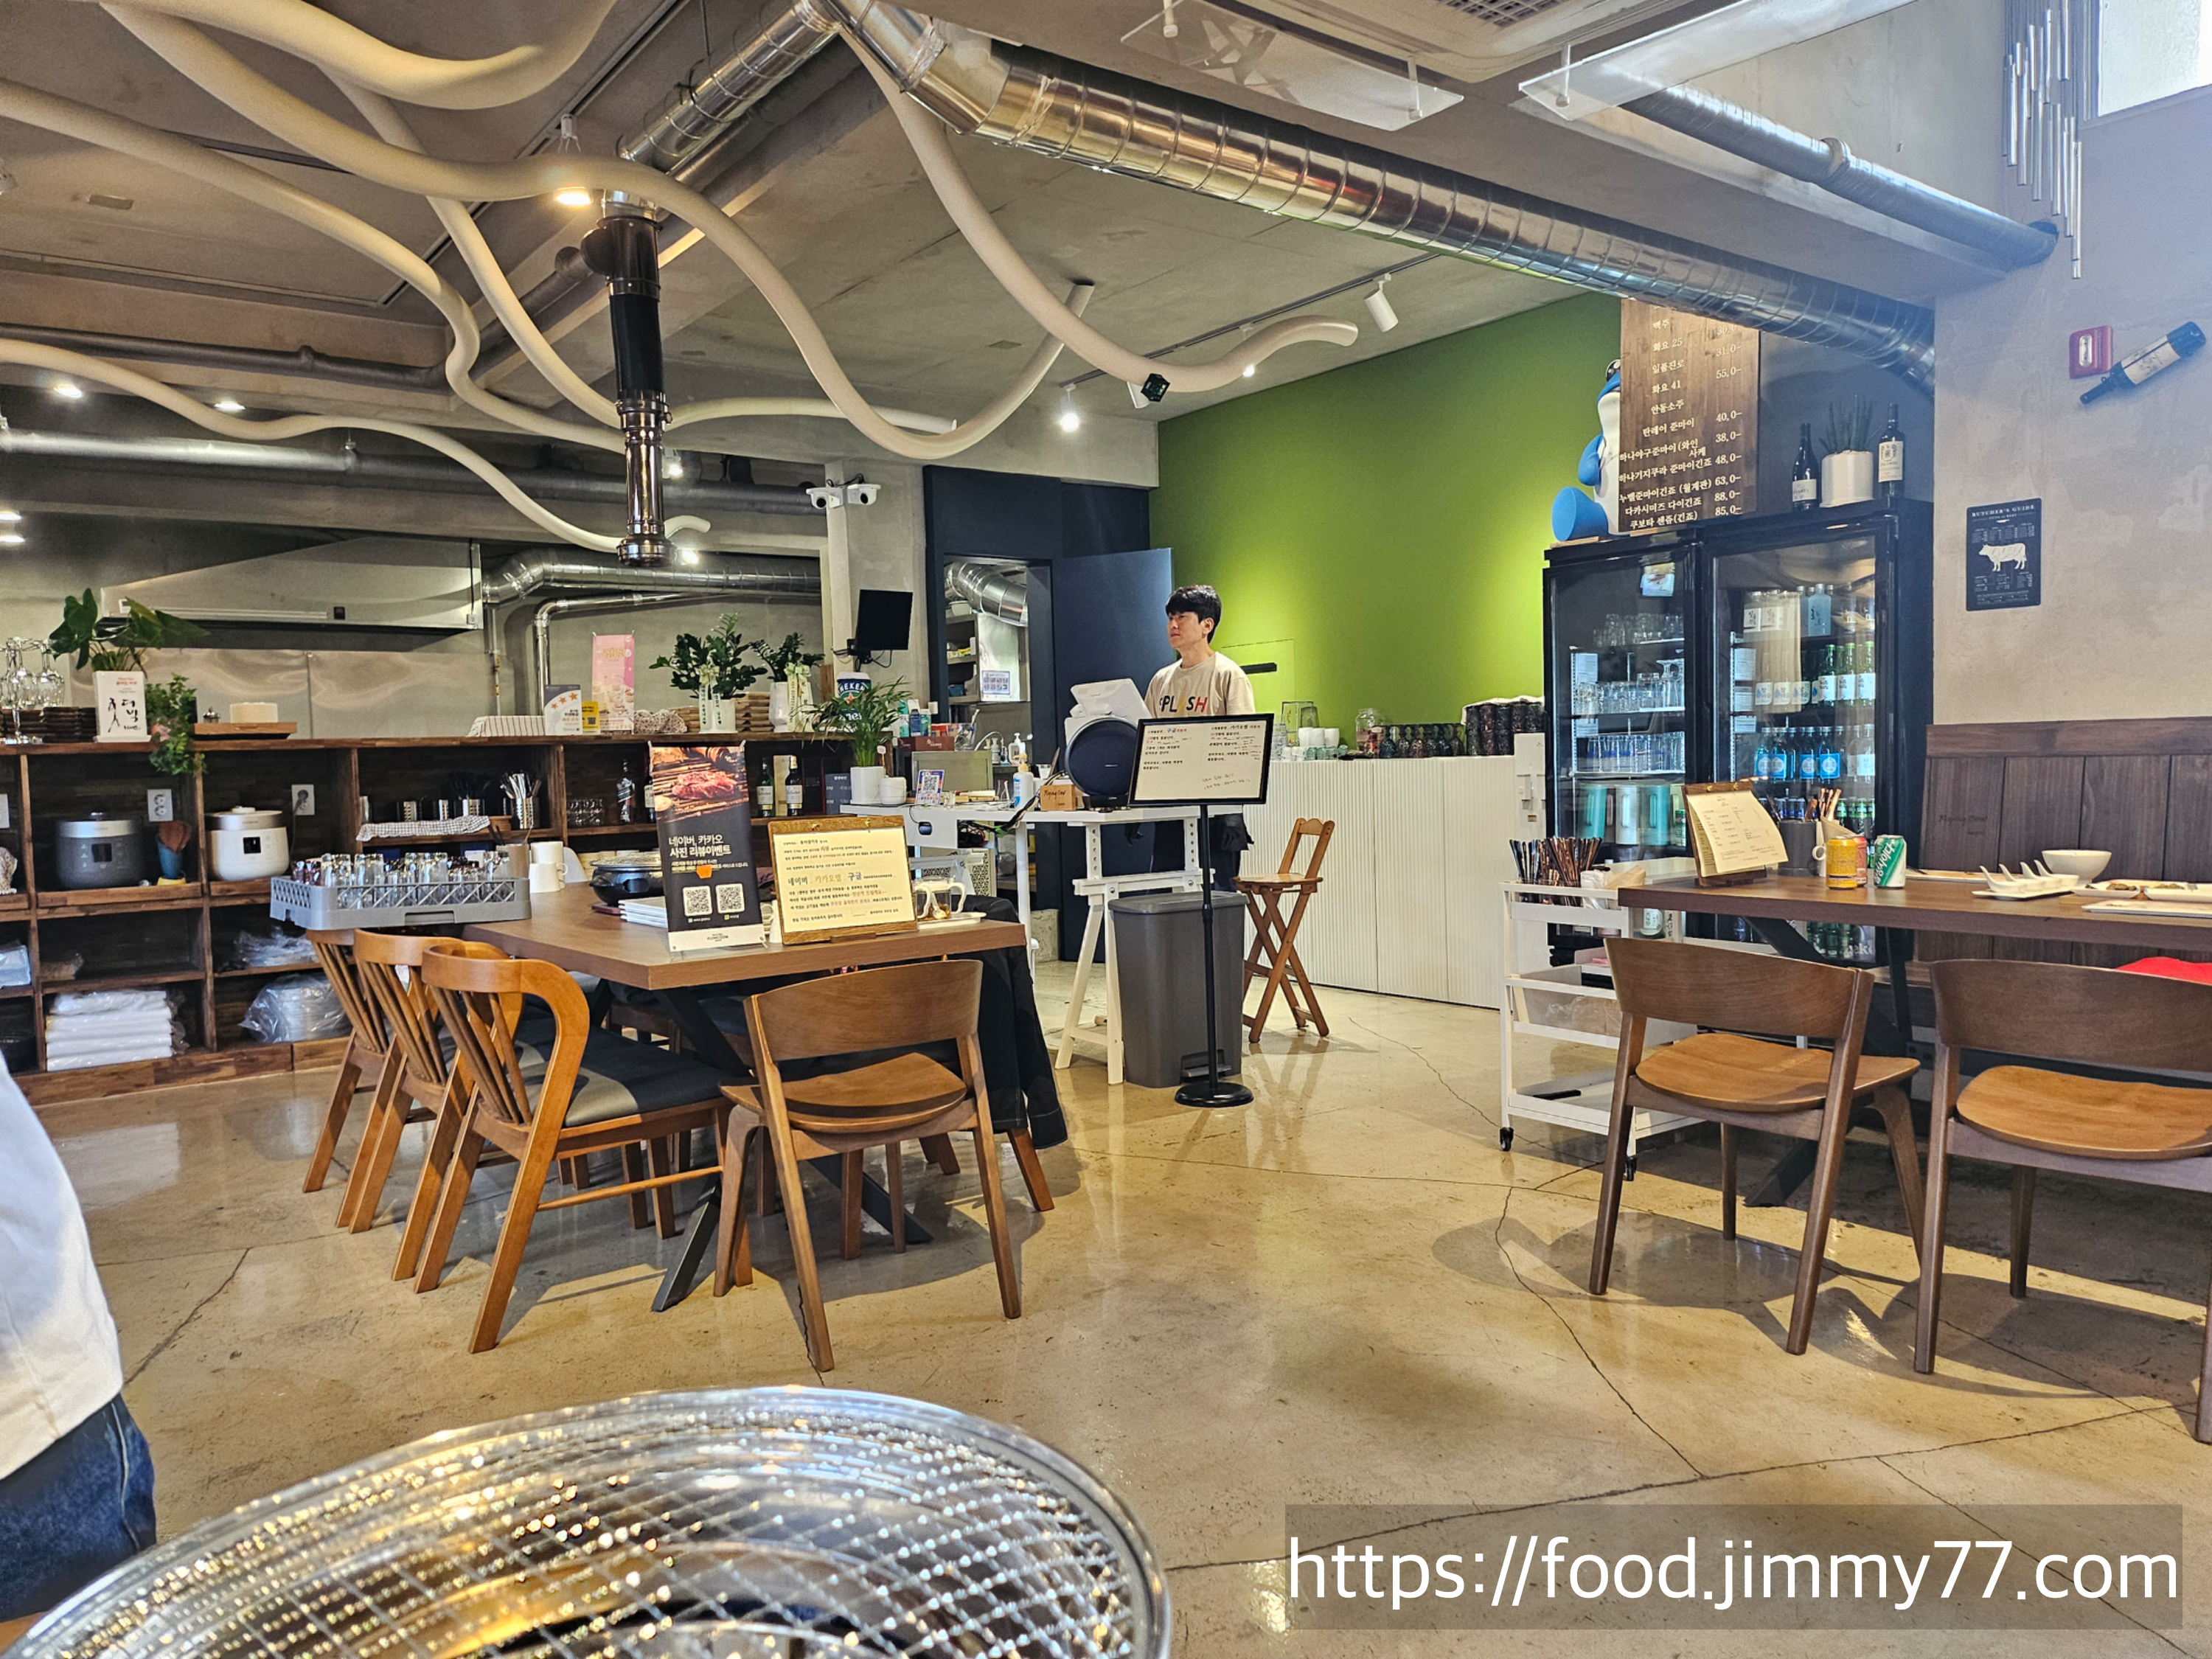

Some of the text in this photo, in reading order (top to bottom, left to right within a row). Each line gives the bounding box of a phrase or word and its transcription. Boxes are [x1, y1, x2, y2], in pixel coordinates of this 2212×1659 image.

[1672, 338, 1683, 348] 25
[1671, 380, 1681, 389] 41
[698, 834, 724, 845] 카카오
[669, 844, 732, 858] 사진 리뷰이벤트
[847, 872, 863, 881] 구글
